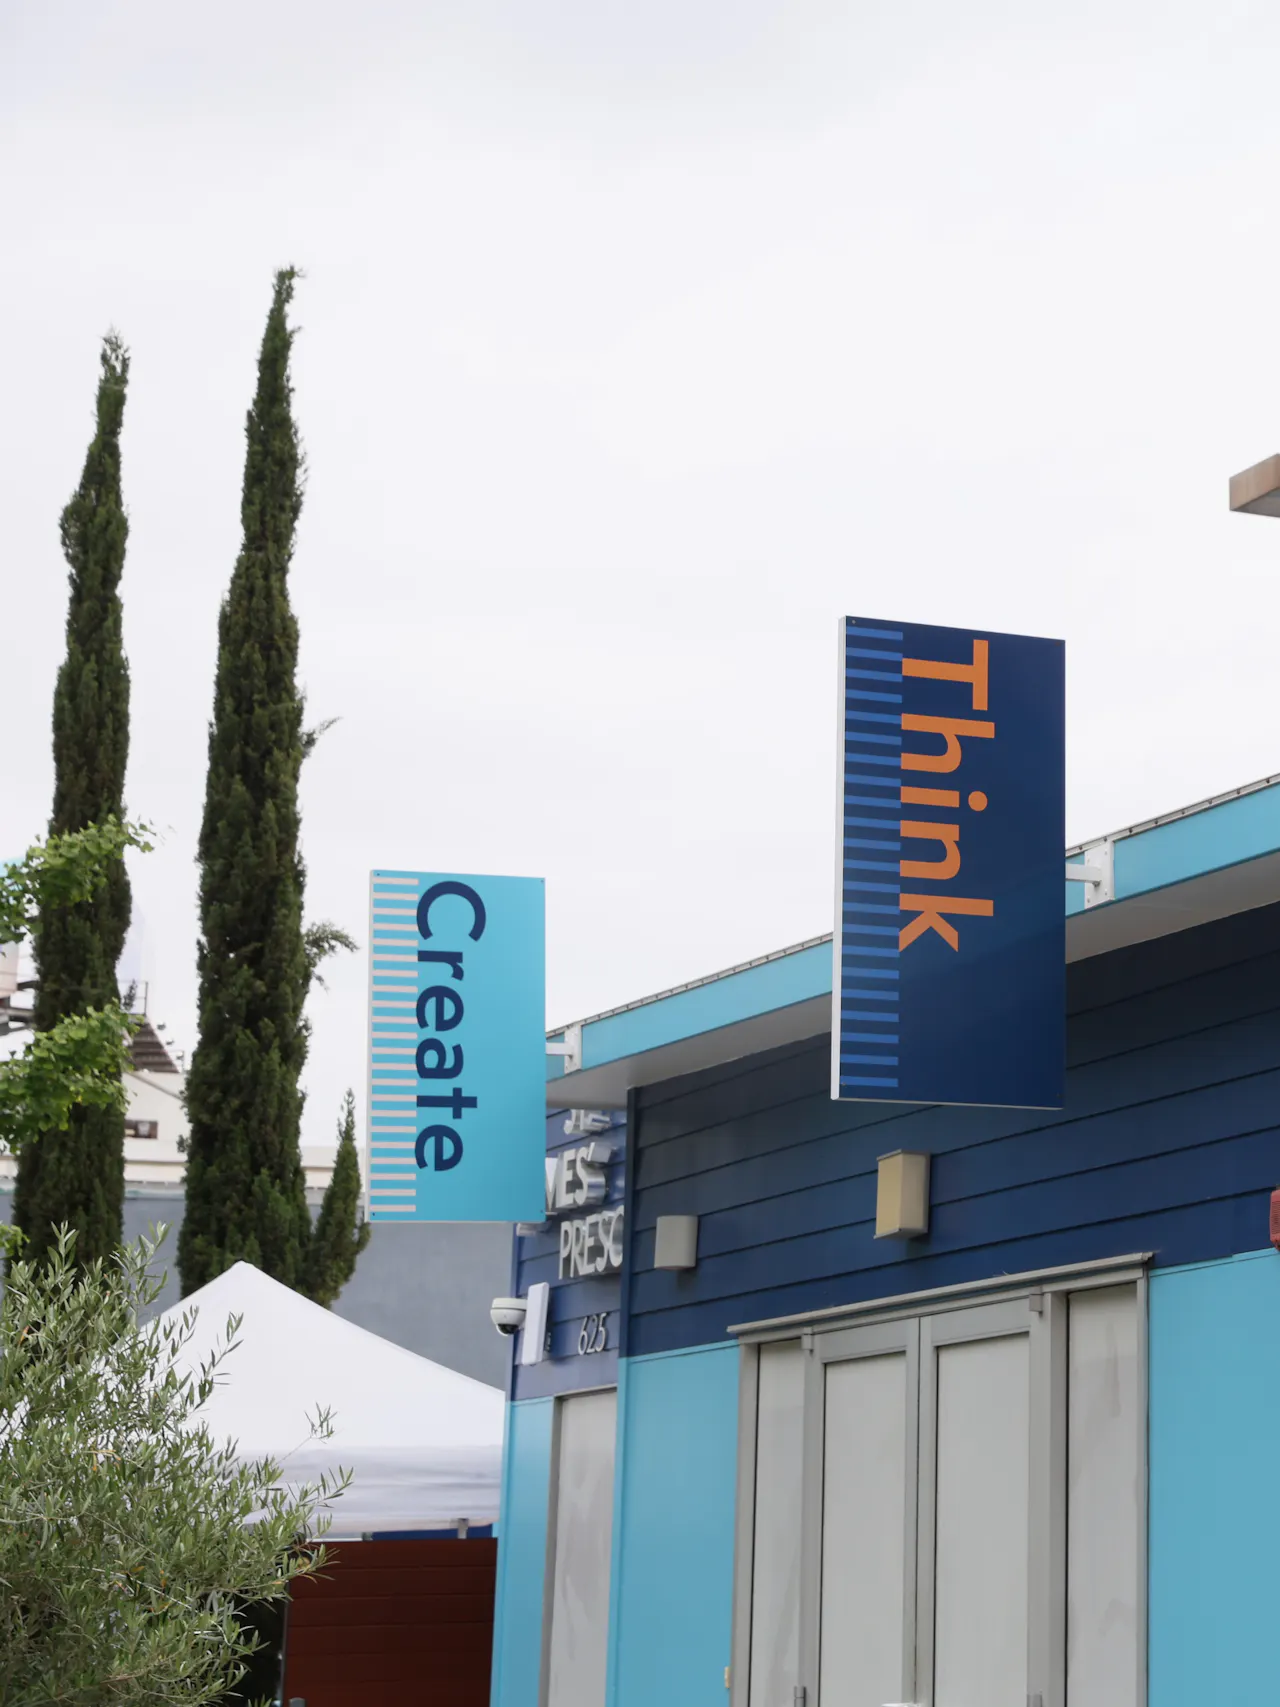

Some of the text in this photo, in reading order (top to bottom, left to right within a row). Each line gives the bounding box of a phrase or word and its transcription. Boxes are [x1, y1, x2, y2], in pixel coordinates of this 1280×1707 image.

[898, 639, 995, 952] Think
[415, 880, 486, 1171] Create
[578, 1312, 608, 1355] 625
